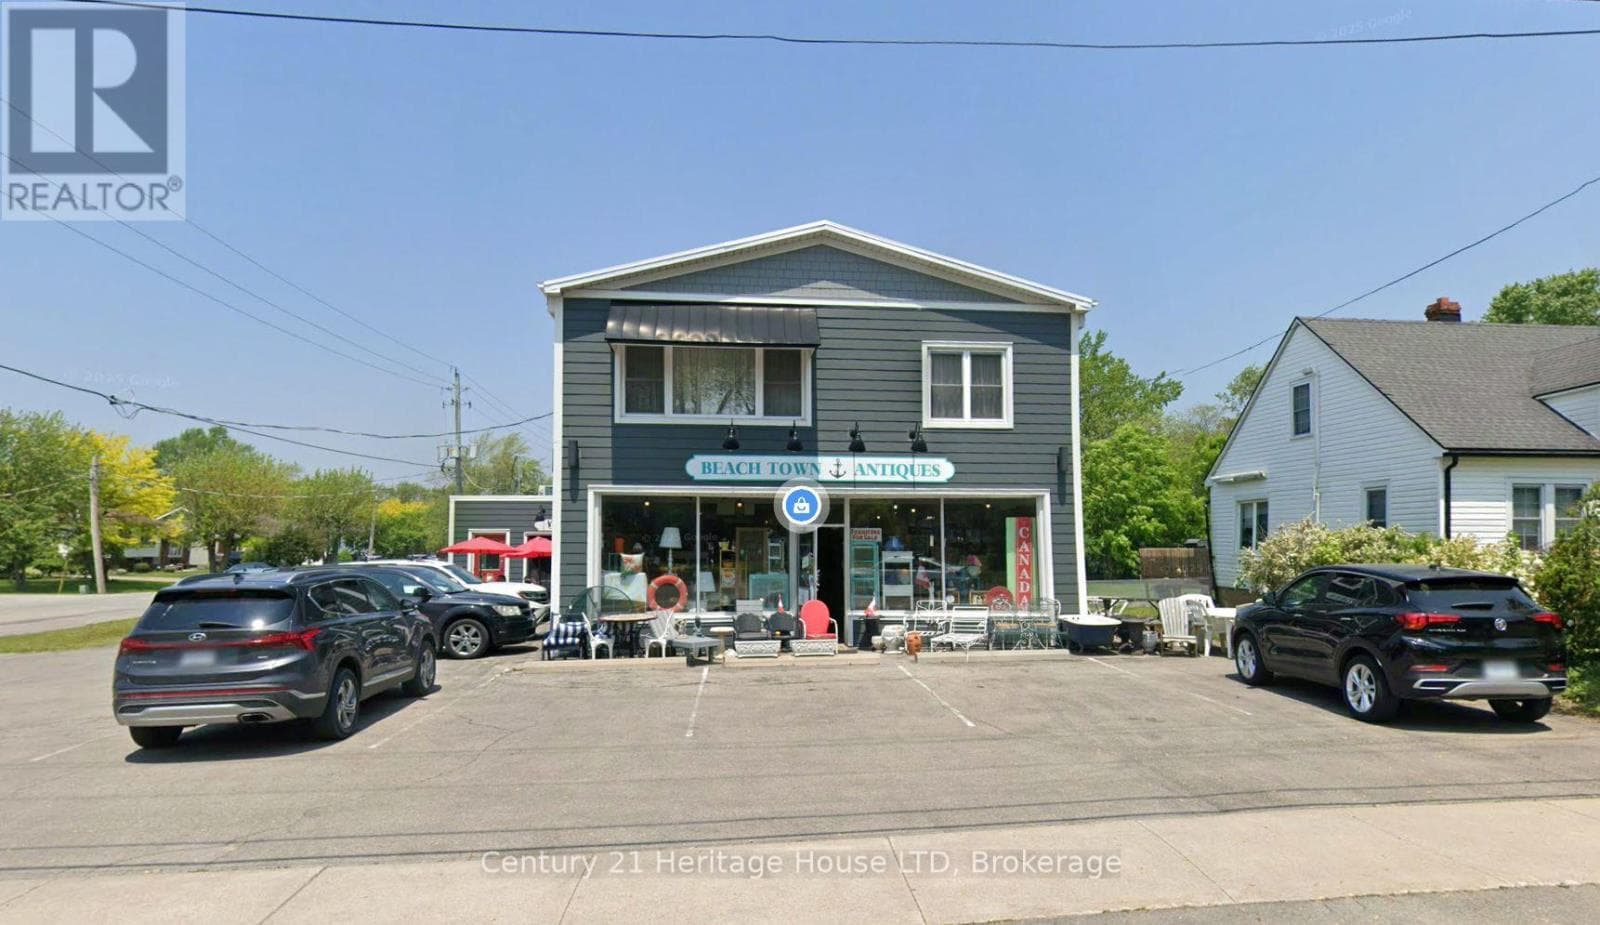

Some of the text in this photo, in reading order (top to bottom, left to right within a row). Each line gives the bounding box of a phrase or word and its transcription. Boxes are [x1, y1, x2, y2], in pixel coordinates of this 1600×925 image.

[701, 461, 941, 480] BEACH TOWN ANTIQUES
[1018, 526, 1031, 610] CANADA
